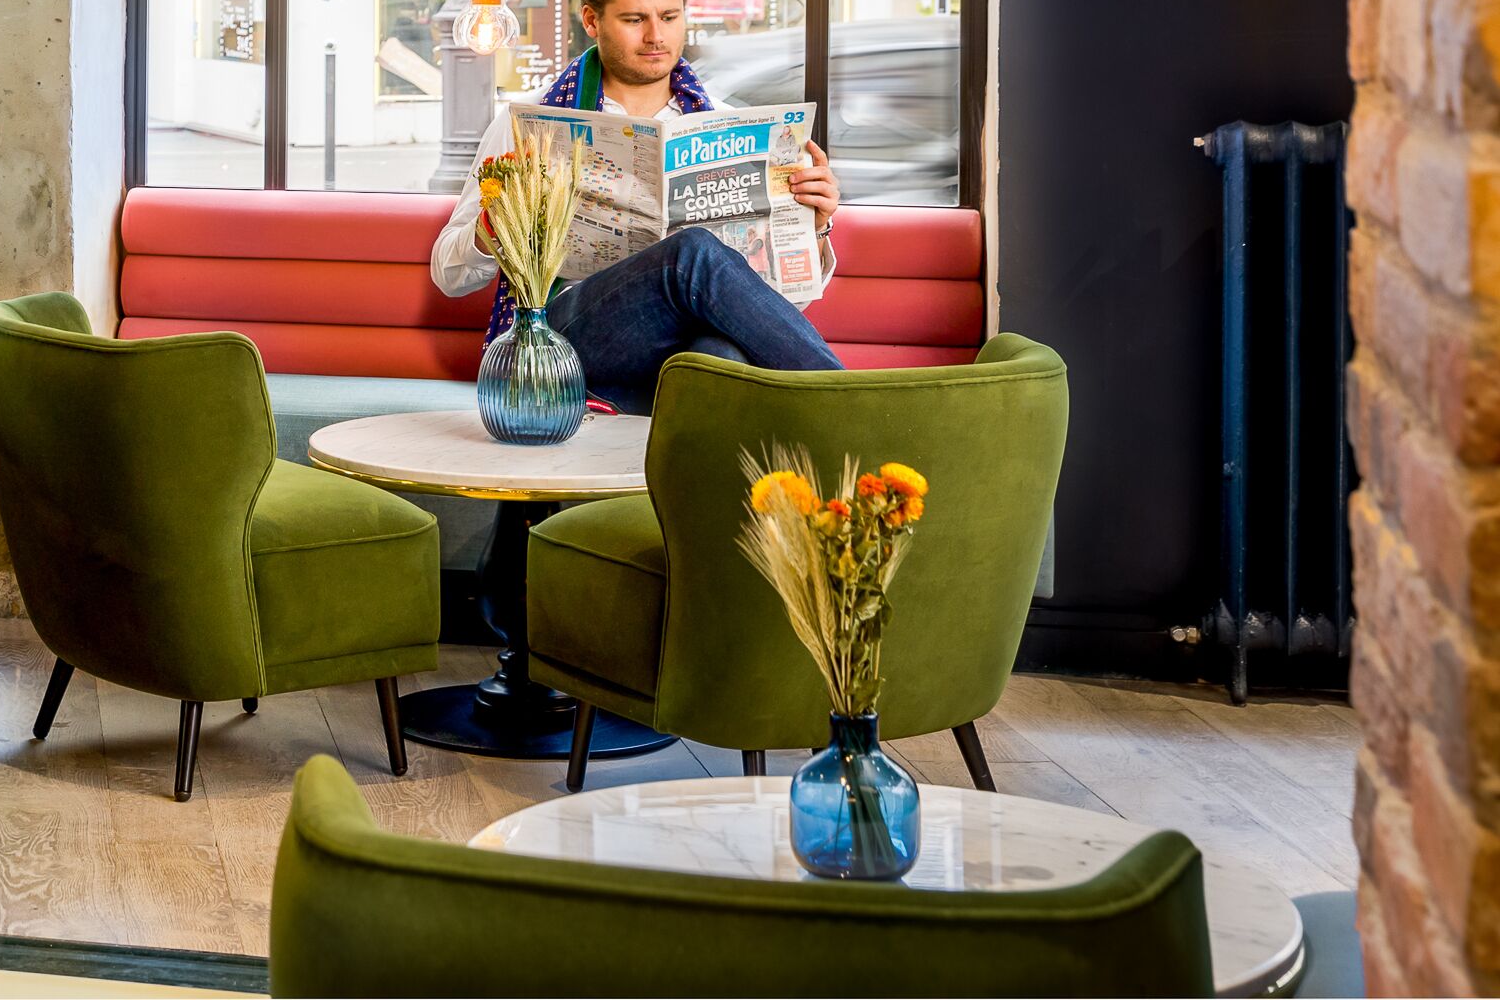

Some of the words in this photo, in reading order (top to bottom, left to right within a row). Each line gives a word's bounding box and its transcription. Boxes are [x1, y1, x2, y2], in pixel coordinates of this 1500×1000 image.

[783, 111, 805, 125] 93
[674, 147, 688, 169] Le
[690, 132, 756, 165] Parisien
[673, 185, 695, 201] LA
[696, 172, 761, 196] FRANCE
[696, 167, 737, 183] GRÈVES
[684, 187, 749, 212] COUPÉE
[685, 208, 709, 222] EN
[710, 201, 755, 220] DEUX
